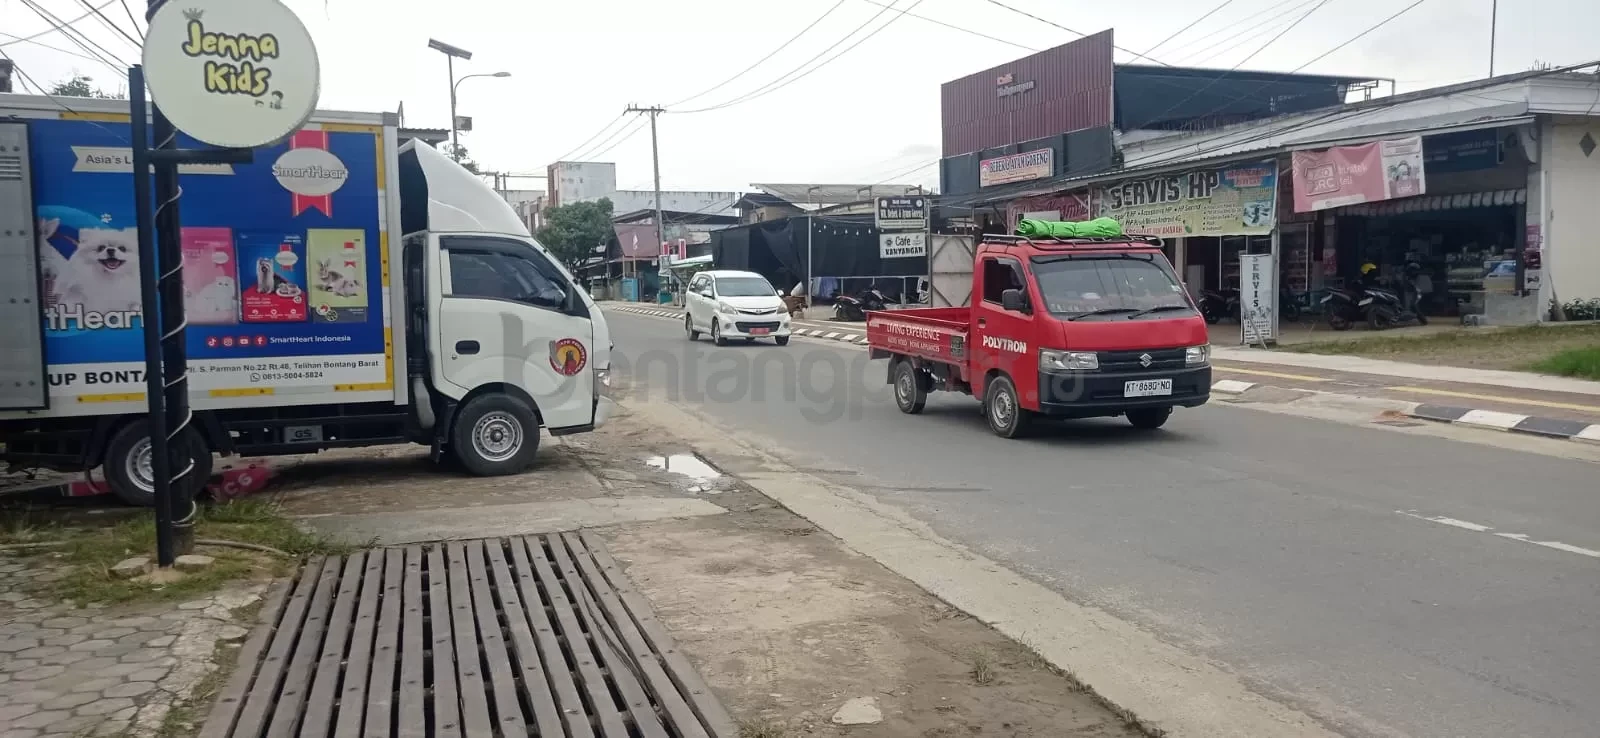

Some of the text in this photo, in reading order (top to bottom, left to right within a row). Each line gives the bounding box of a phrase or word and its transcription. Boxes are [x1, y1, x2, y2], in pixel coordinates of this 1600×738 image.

[182, 19, 279, 61] Jenna
[204, 61, 272, 97] Kids
[85, 153, 122, 165] Asia's
[1026, 151, 1048, 167] GORENG
[272, 163, 348, 180] SmartHeart
[1110, 178, 1180, 210] SERVIS
[1188, 172, 1219, 200] HP
[895, 236, 911, 246] Cafe
[269, 334, 352, 344] SmartHeart Indonesia
[886, 323, 905, 336] LIVING
[905, 325, 941, 341] EXPERIENCE
[982, 334, 1028, 355] POLYTRON
[209, 364, 242, 373] Parman
[243, 363, 267, 372] No.22
[294, 361, 322, 370] Telihan
[323, 360, 357, 370] Bontang
[358, 359, 379, 368] Barat
